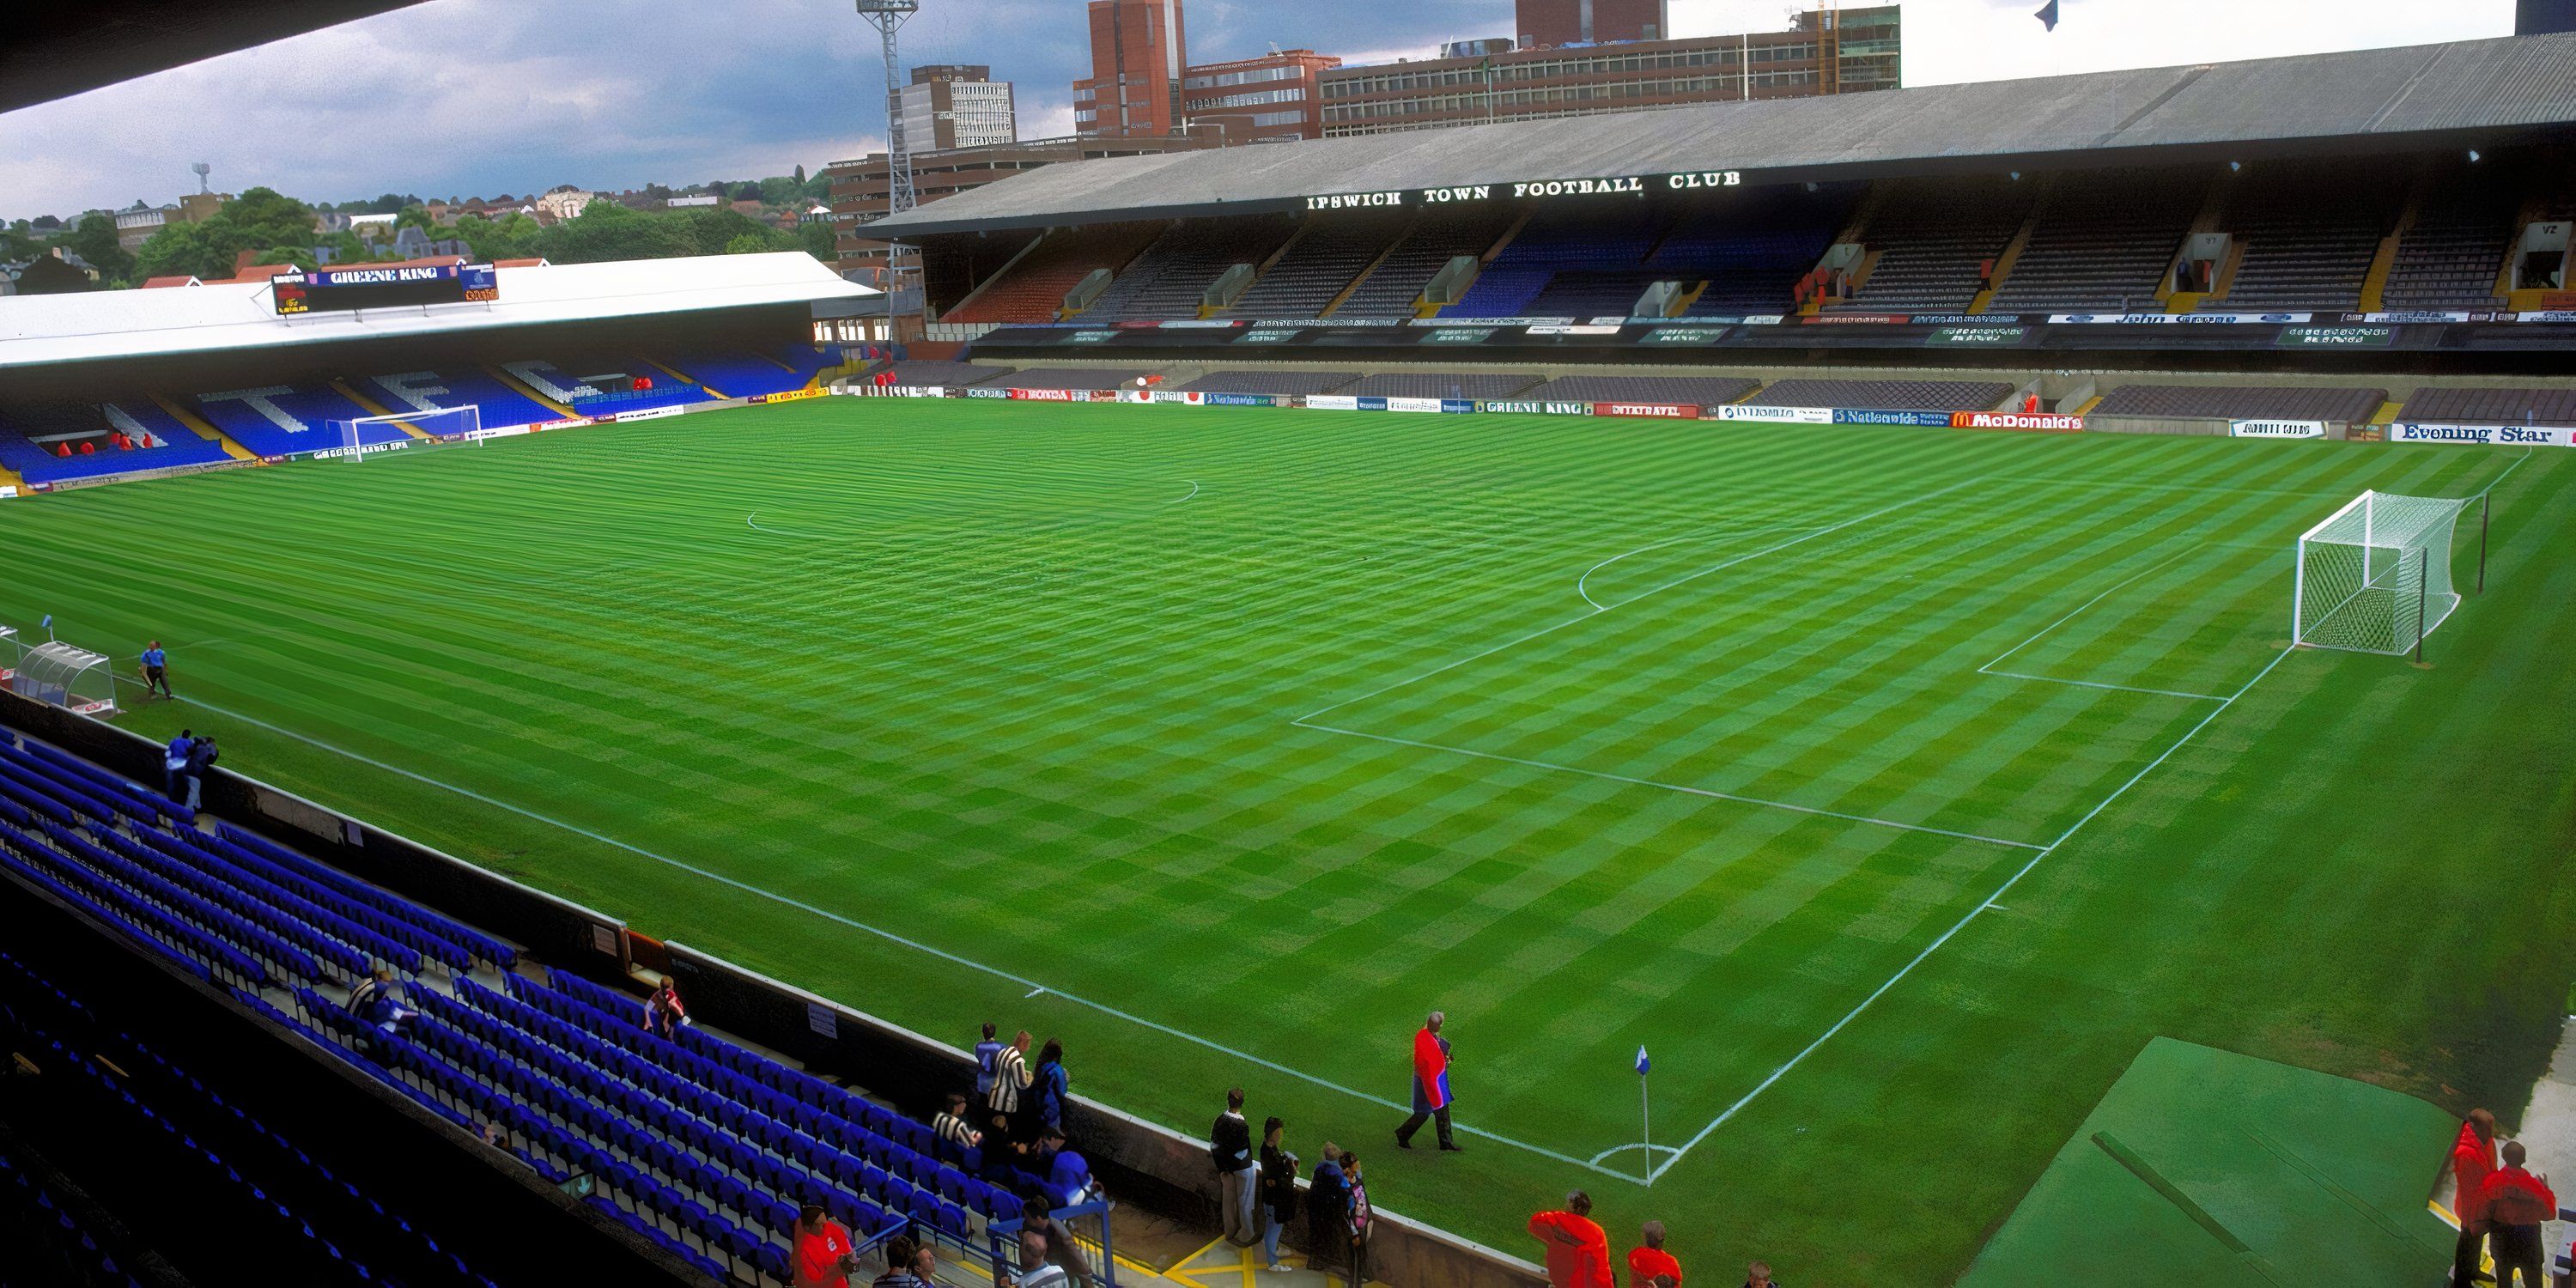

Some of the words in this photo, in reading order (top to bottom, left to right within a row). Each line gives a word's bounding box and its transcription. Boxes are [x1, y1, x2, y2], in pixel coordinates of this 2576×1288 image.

[1307, 191, 1401, 210] IPSWICH
[1424, 185, 1491, 203] TOWN
[1514, 177, 1643, 197] FOOTBALL
[1669, 171, 1741, 189] CLUB
[330, 269, 396, 284] GREENE
[399, 267, 438, 282] KING
[1971, 414, 2082, 429] McDonald's
[2500, 425, 2552, 442] Star
